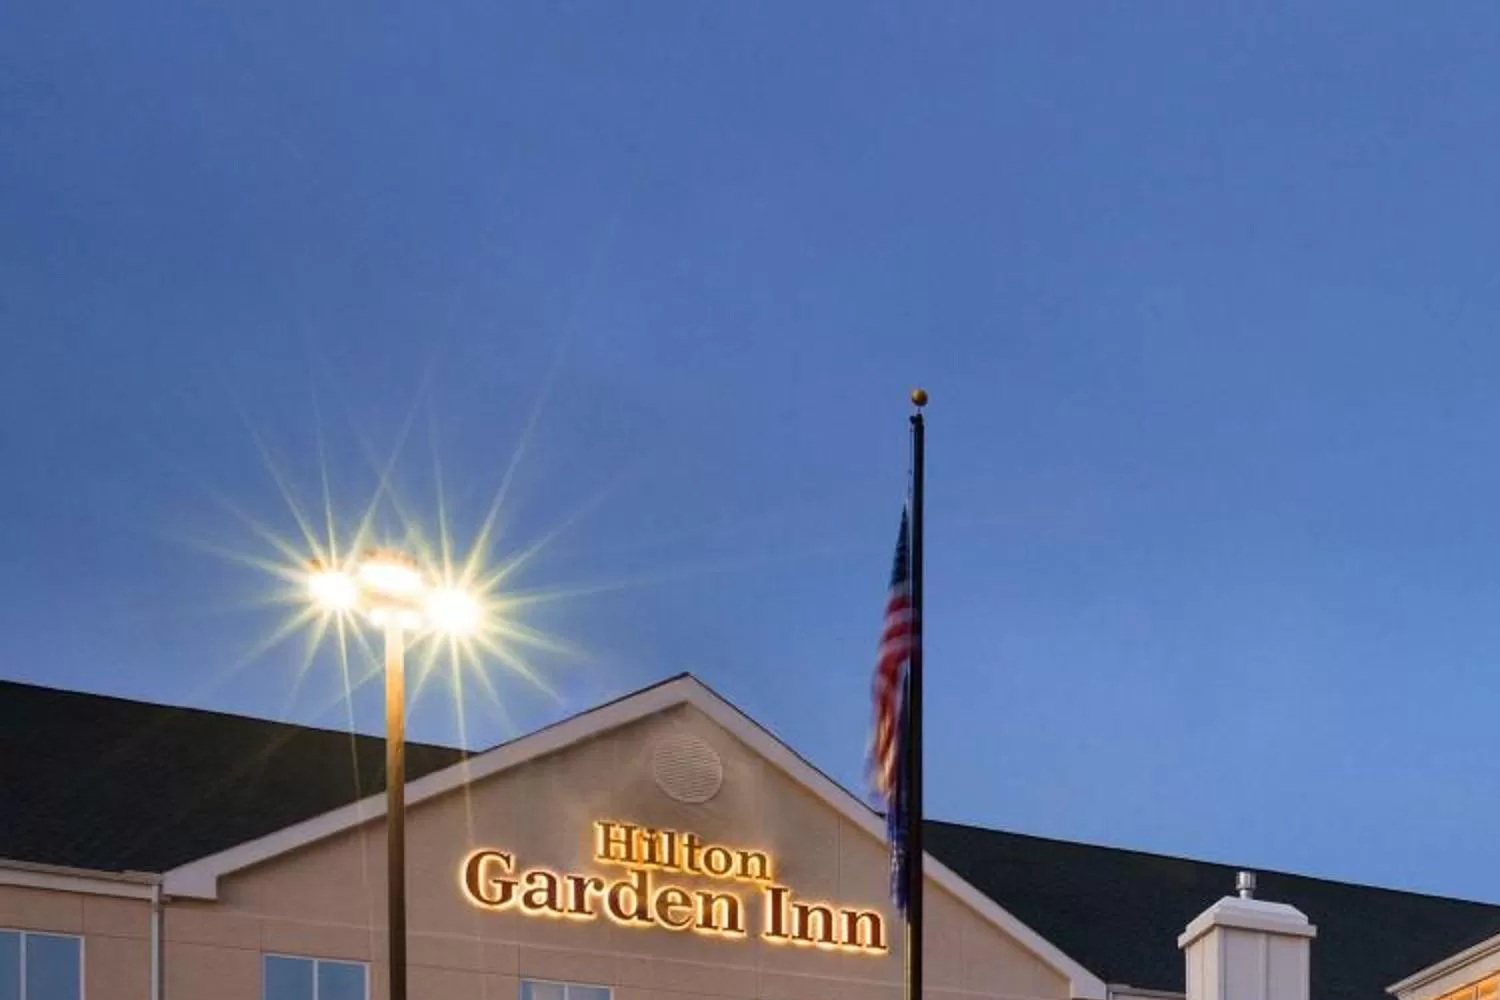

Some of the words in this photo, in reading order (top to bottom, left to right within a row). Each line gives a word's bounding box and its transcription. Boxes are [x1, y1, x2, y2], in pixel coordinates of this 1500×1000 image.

[594, 820, 772, 881] Hilton
[464, 850, 745, 932] Garden
[765, 886, 887, 950] Inn
